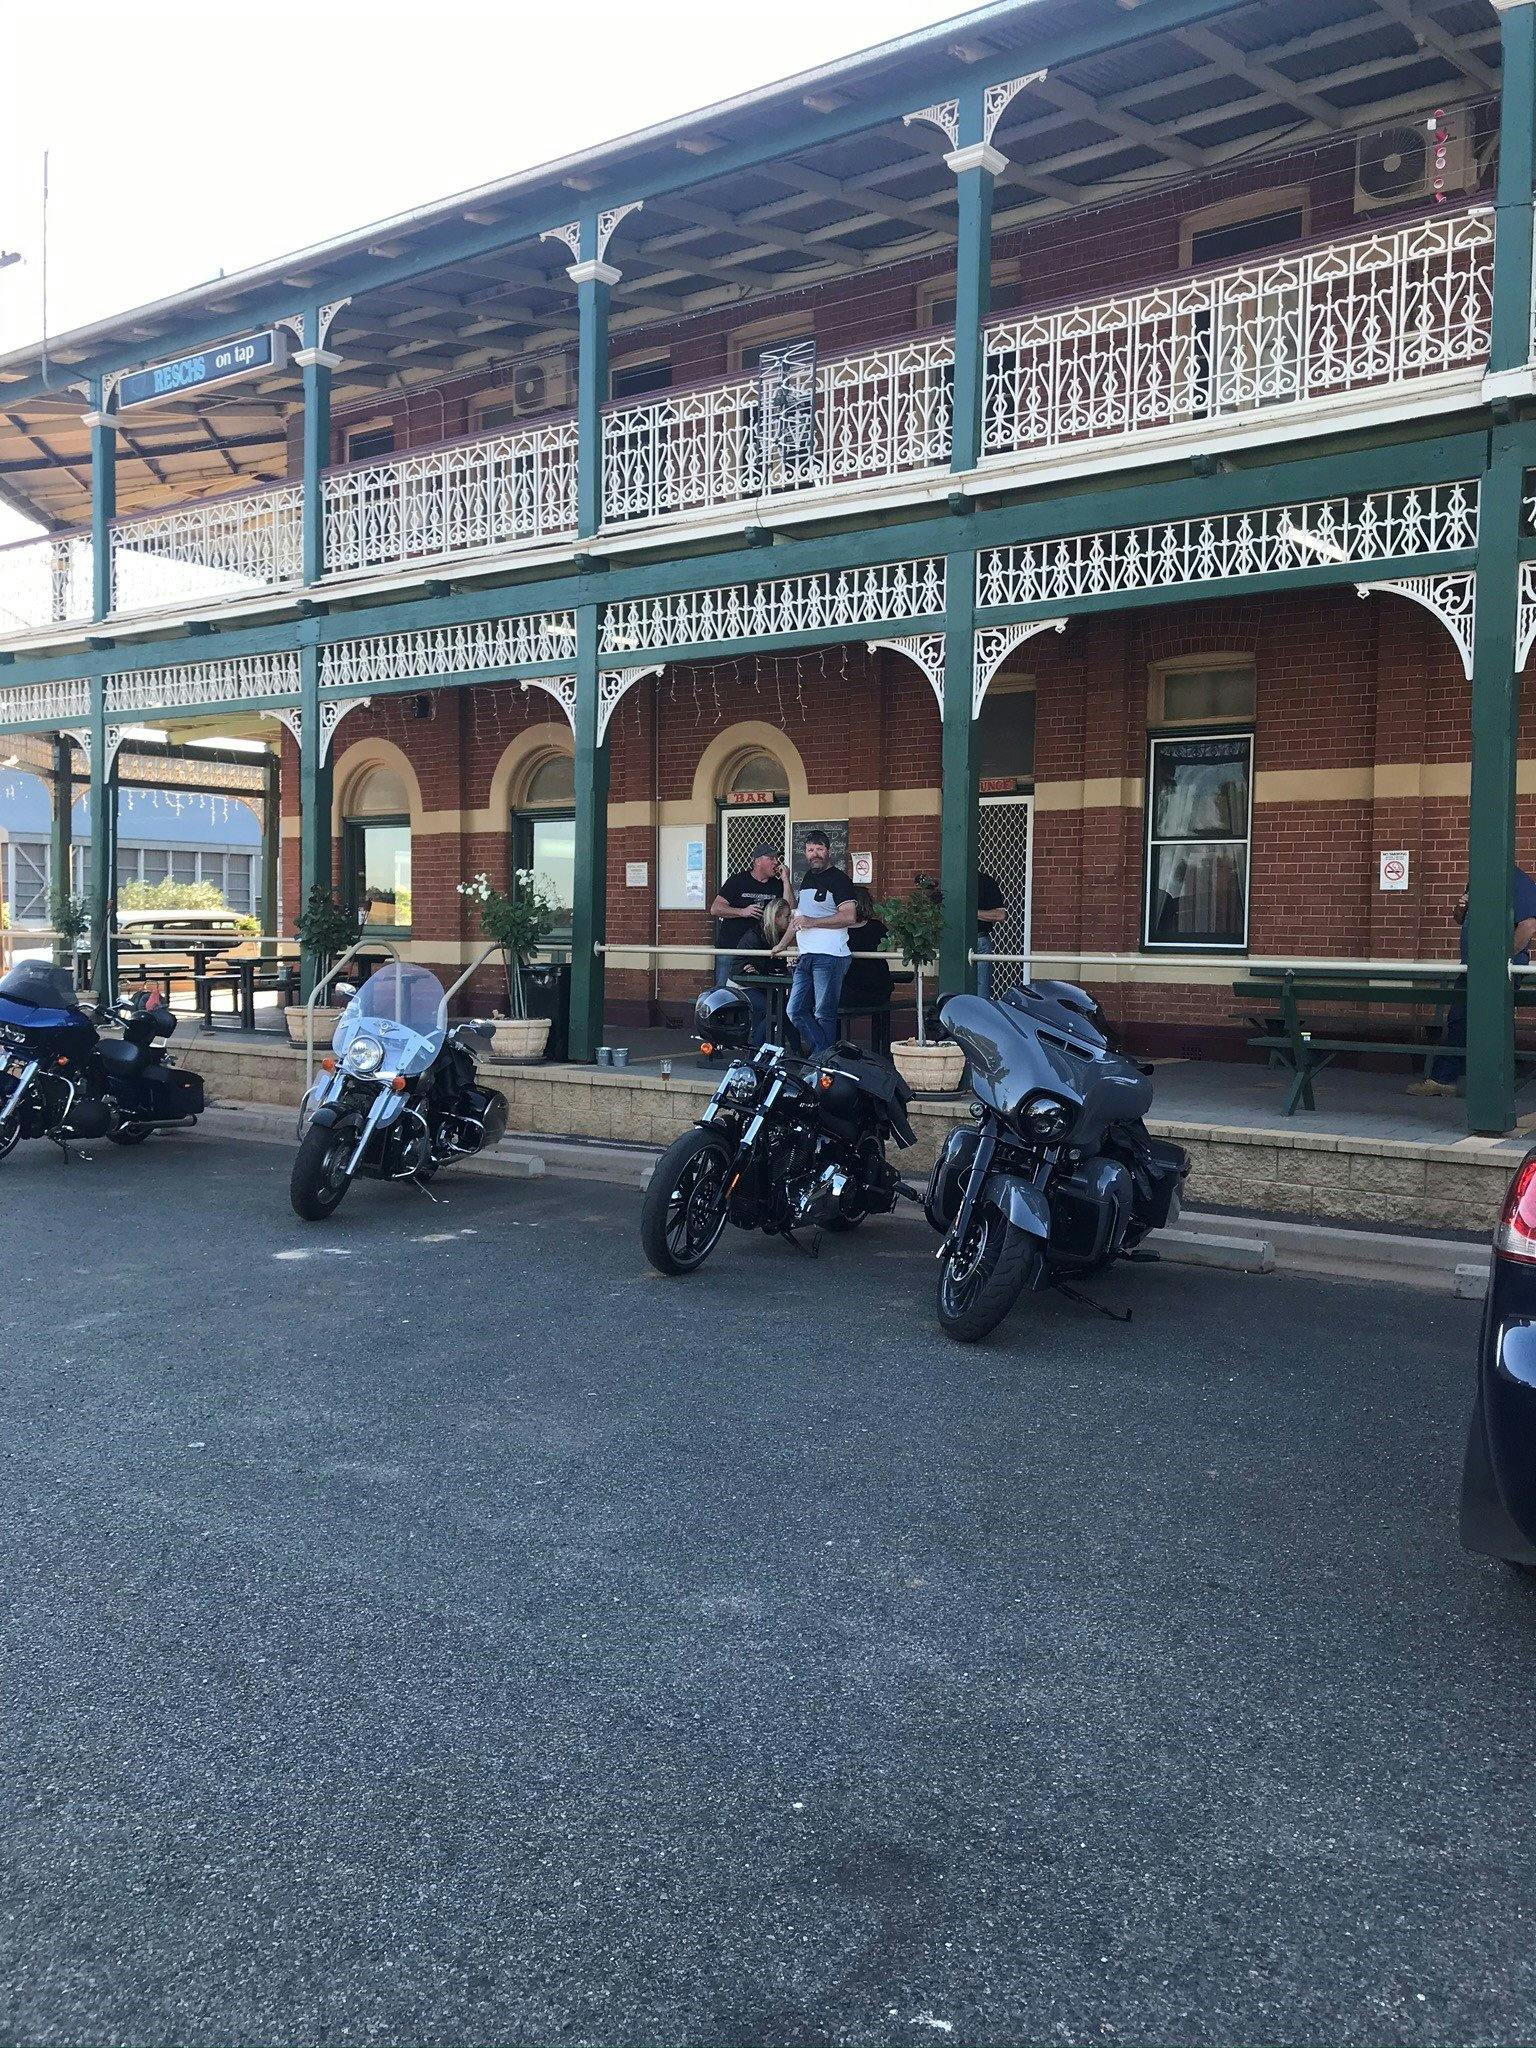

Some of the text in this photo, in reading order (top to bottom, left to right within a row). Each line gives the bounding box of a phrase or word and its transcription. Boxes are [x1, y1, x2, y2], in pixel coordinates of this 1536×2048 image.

[215, 352, 231, 368] on
[234, 345, 255, 364] tap
[733, 793, 766, 803] BAR
